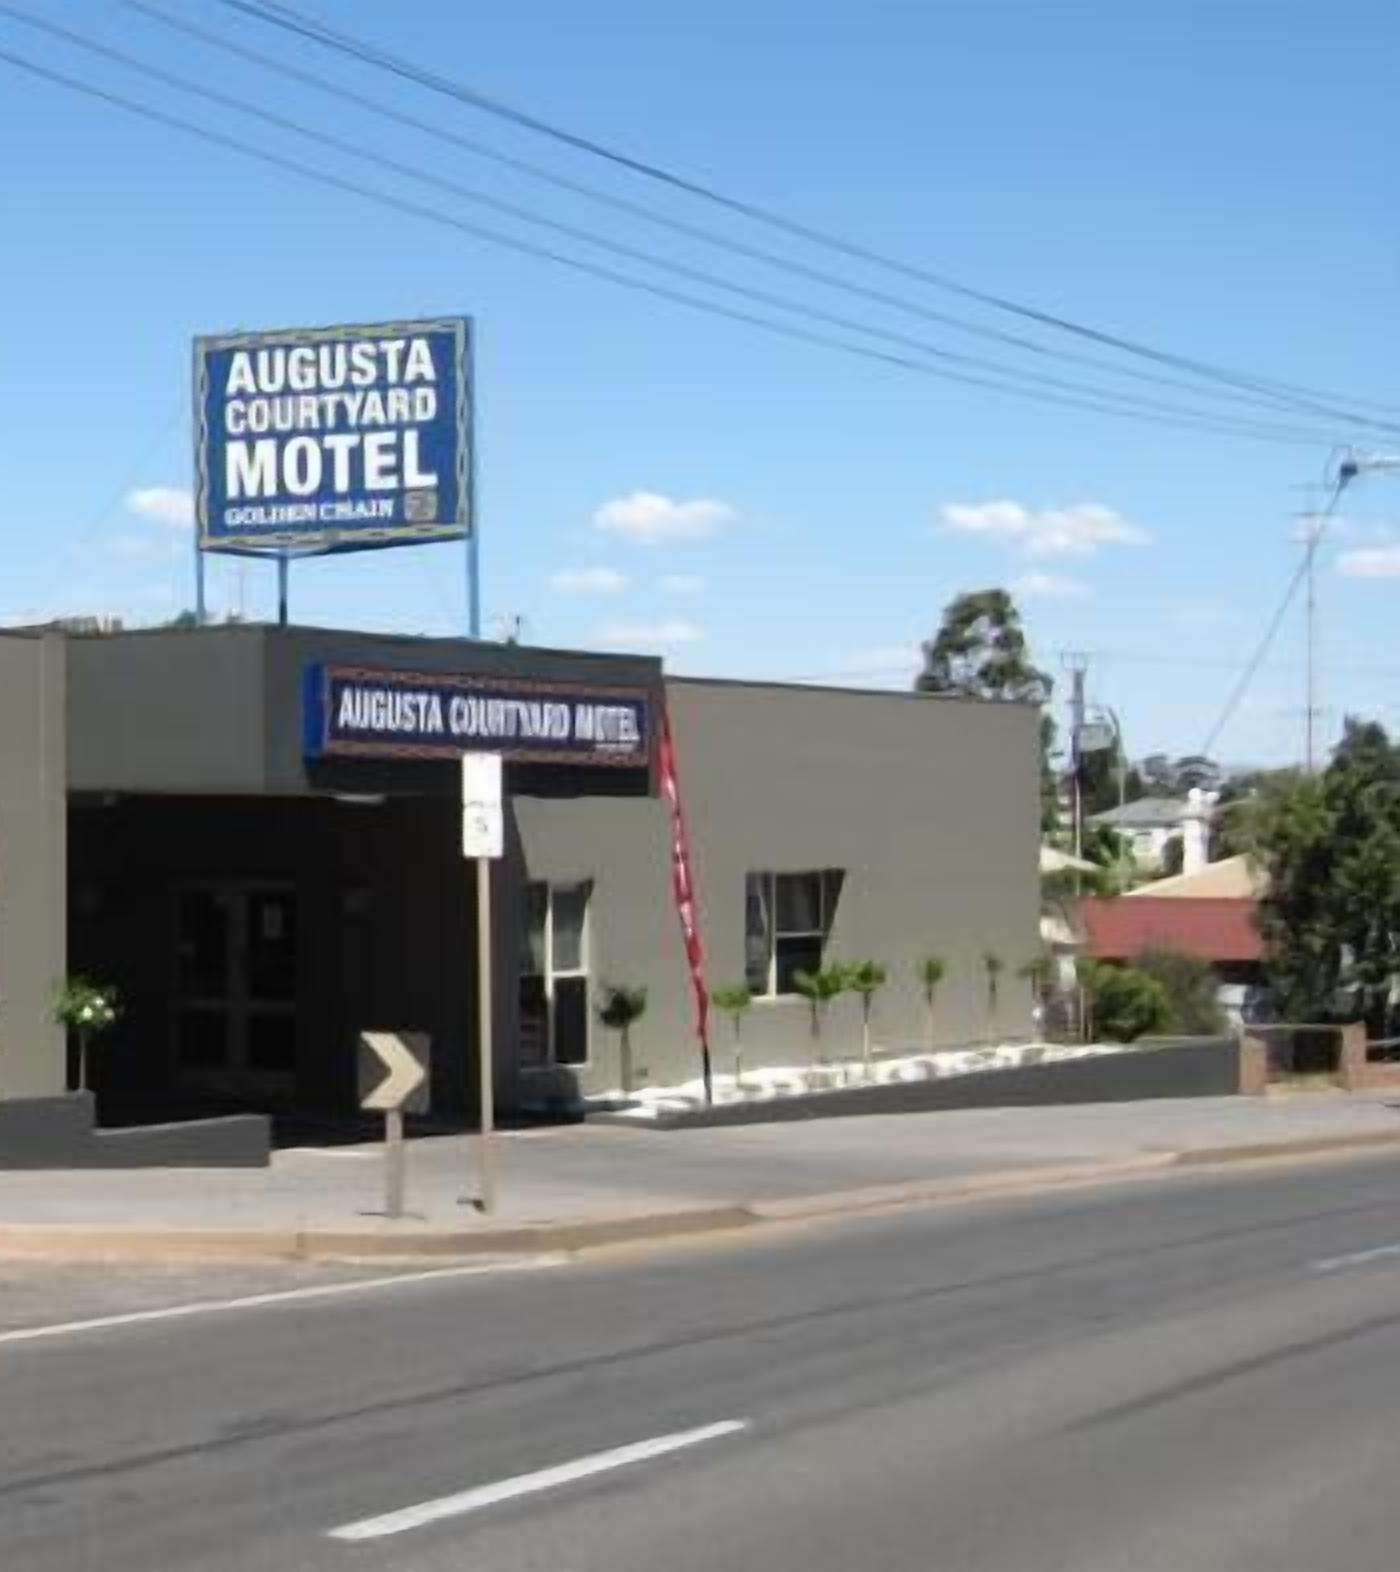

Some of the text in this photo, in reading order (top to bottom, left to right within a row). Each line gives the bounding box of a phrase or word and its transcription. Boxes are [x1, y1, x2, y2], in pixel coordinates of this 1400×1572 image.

[226, 338, 436, 394] AUGUSTA
[225, 387, 436, 433] COURTYARD
[226, 431, 437, 498] MOTEL
[338, 687, 444, 733] AUGUSTA
